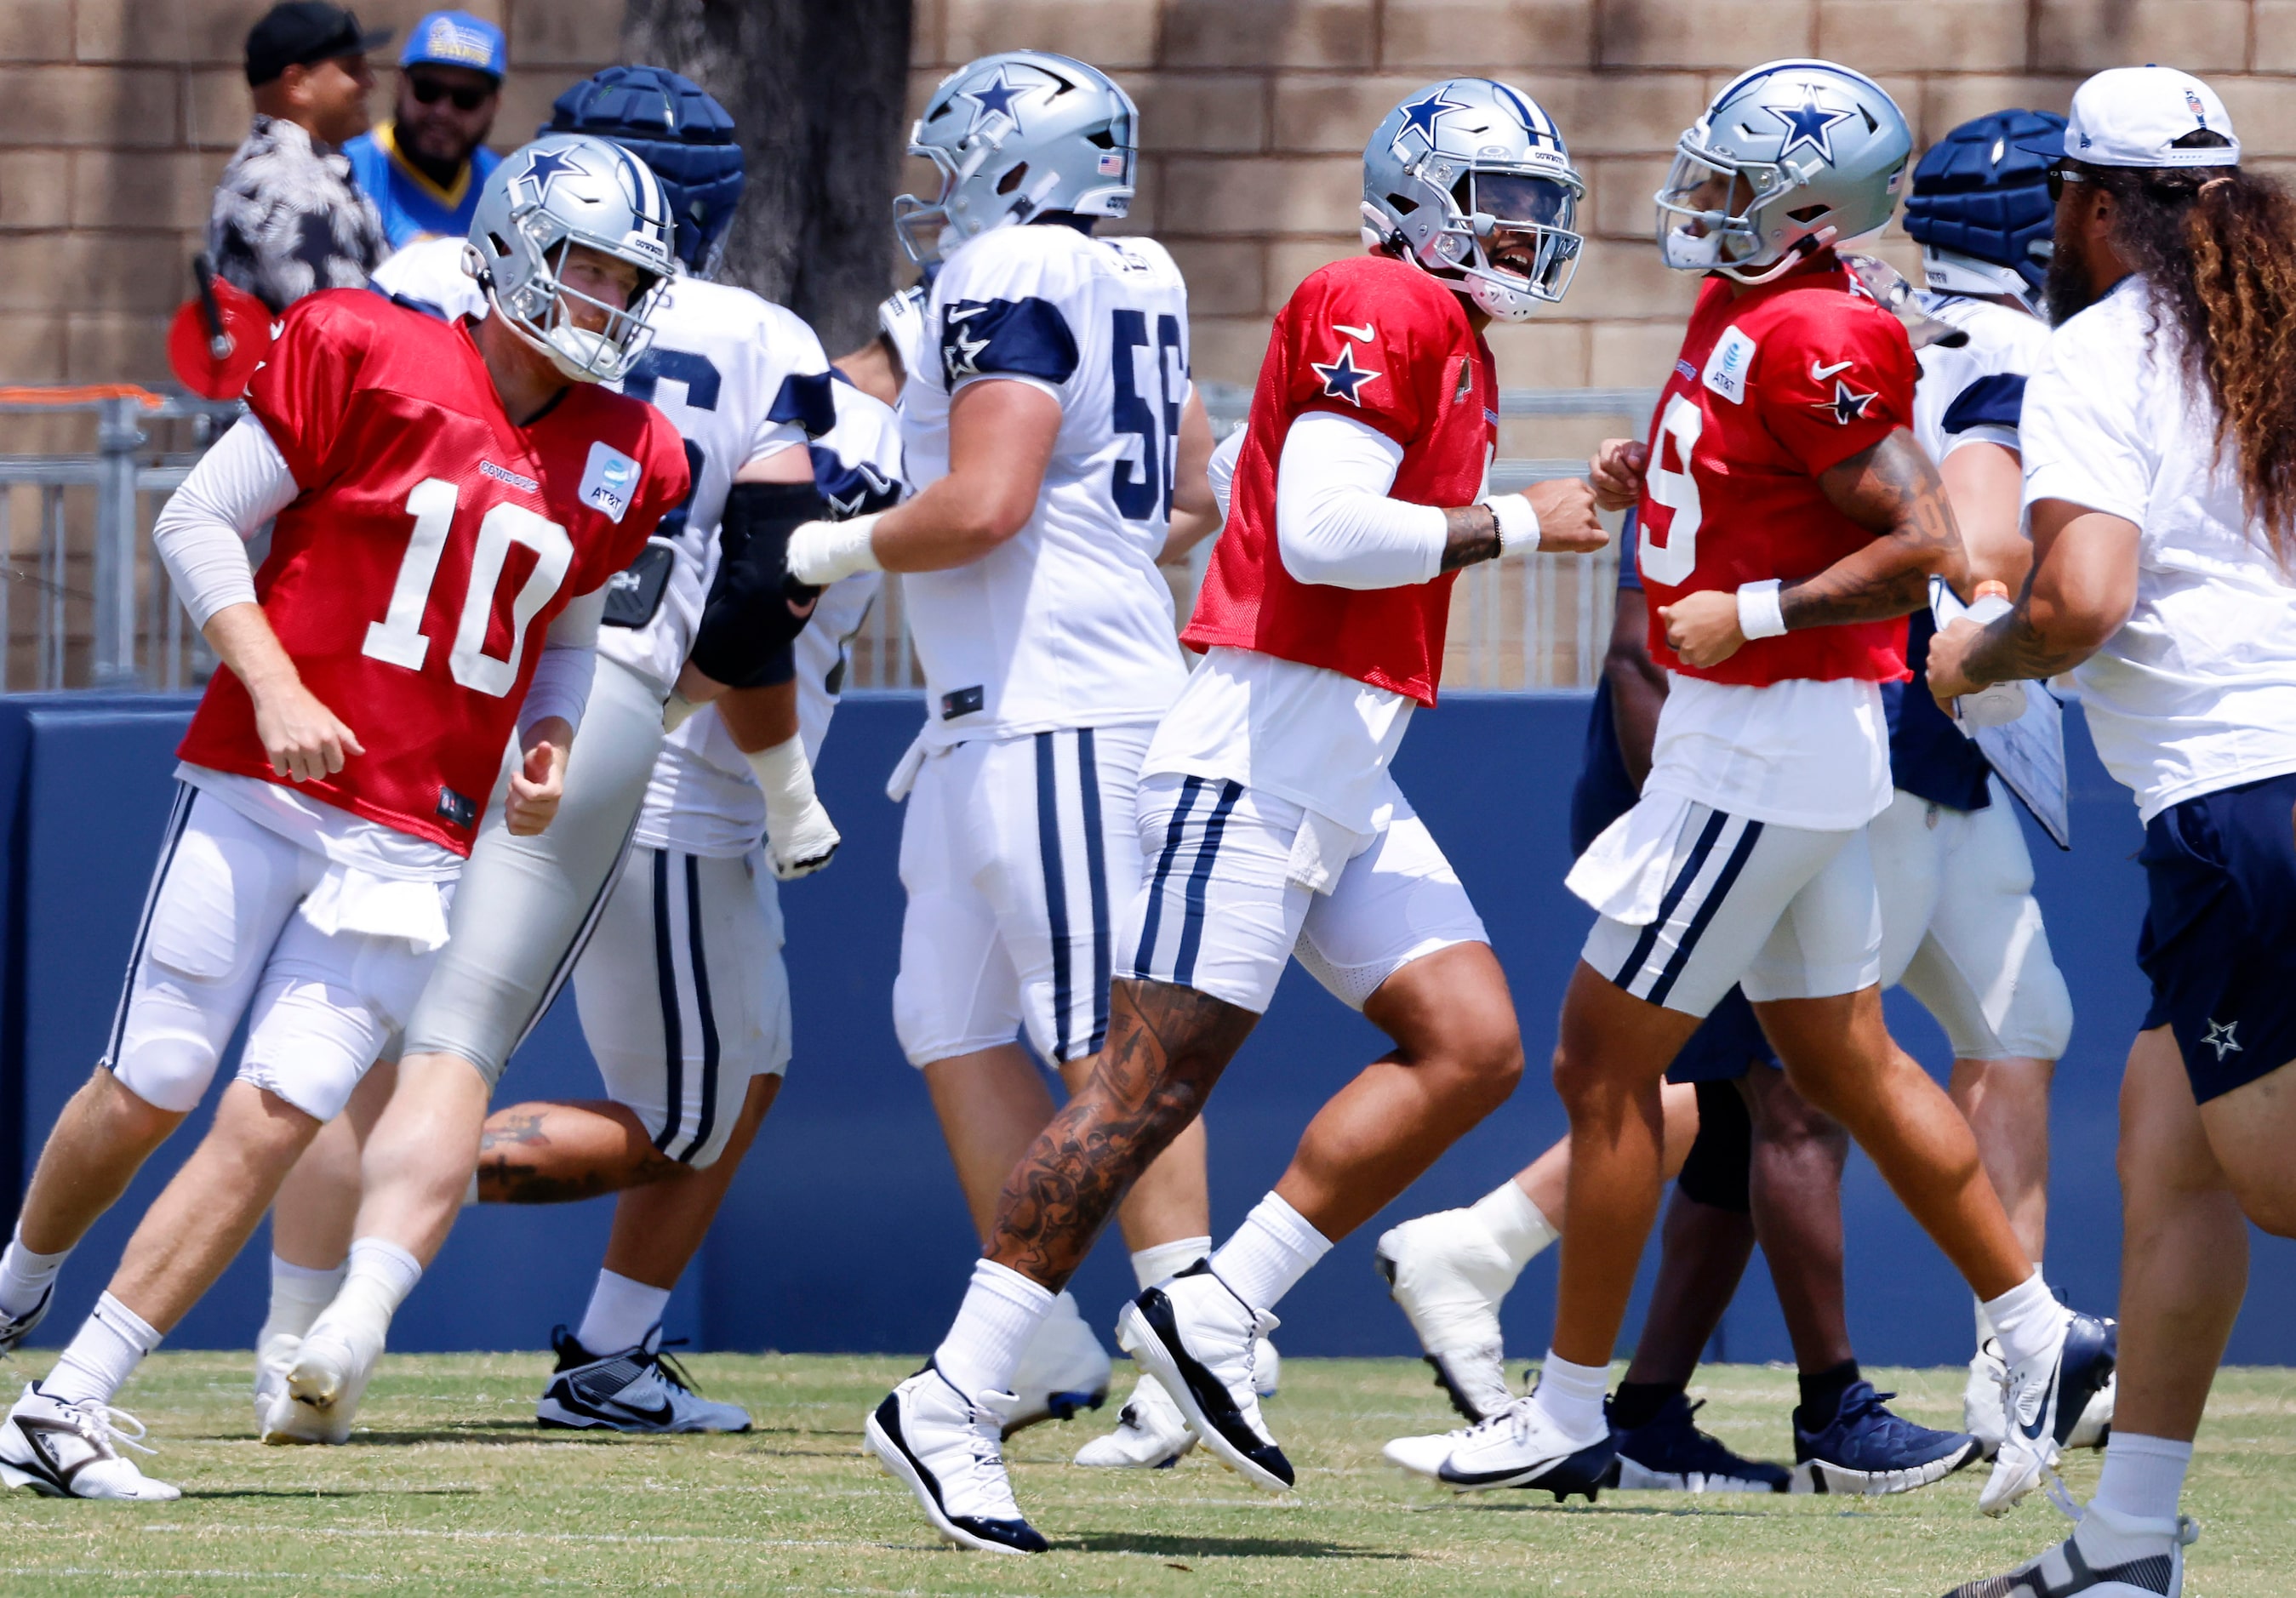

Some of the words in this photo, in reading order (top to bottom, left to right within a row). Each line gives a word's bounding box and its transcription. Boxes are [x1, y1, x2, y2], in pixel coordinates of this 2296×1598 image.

[1712, 371, 1735, 393] AT&T
[591, 486, 622, 511] AT&T
[361, 477, 575, 699] 10
